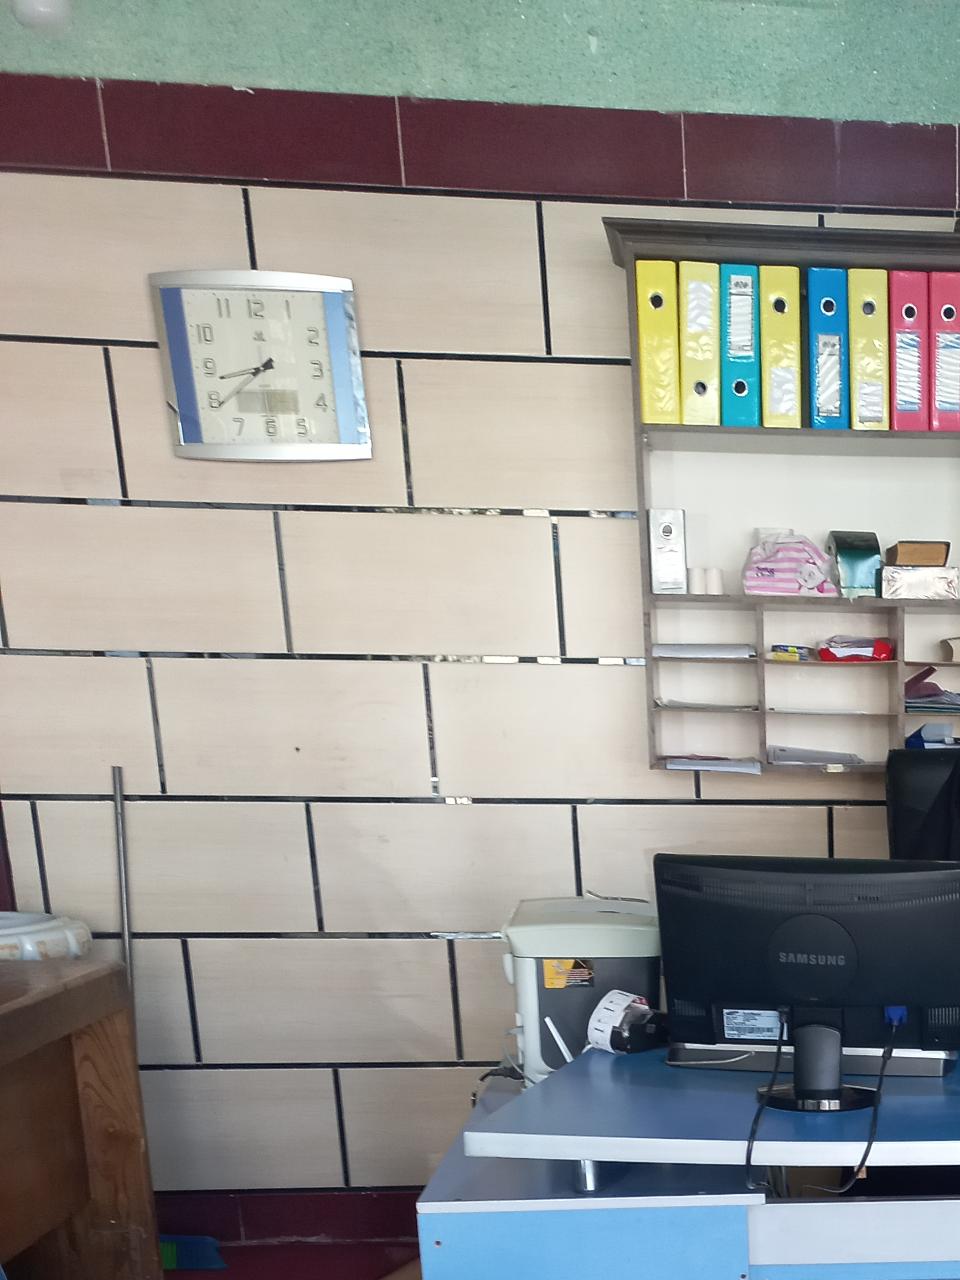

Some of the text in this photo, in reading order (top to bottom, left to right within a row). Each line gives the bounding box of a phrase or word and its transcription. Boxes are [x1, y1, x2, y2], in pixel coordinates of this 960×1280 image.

[217, 298, 231, 318] 11
[247, 299, 264, 318] 12
[285, 300, 292, 319] 1
[197, 324, 214, 343] 10
[308, 327, 320, 345] 2
[204, 358, 217, 376] 9
[311, 360, 323, 380] 3
[207, 391, 221, 409] 8
[315, 393, 328, 413] 4
[233, 418, 244, 436] 7
[266, 418, 278, 437] 6
[296, 418, 309, 437] 5
[779, 952, 846, 965] SAMSUNG
